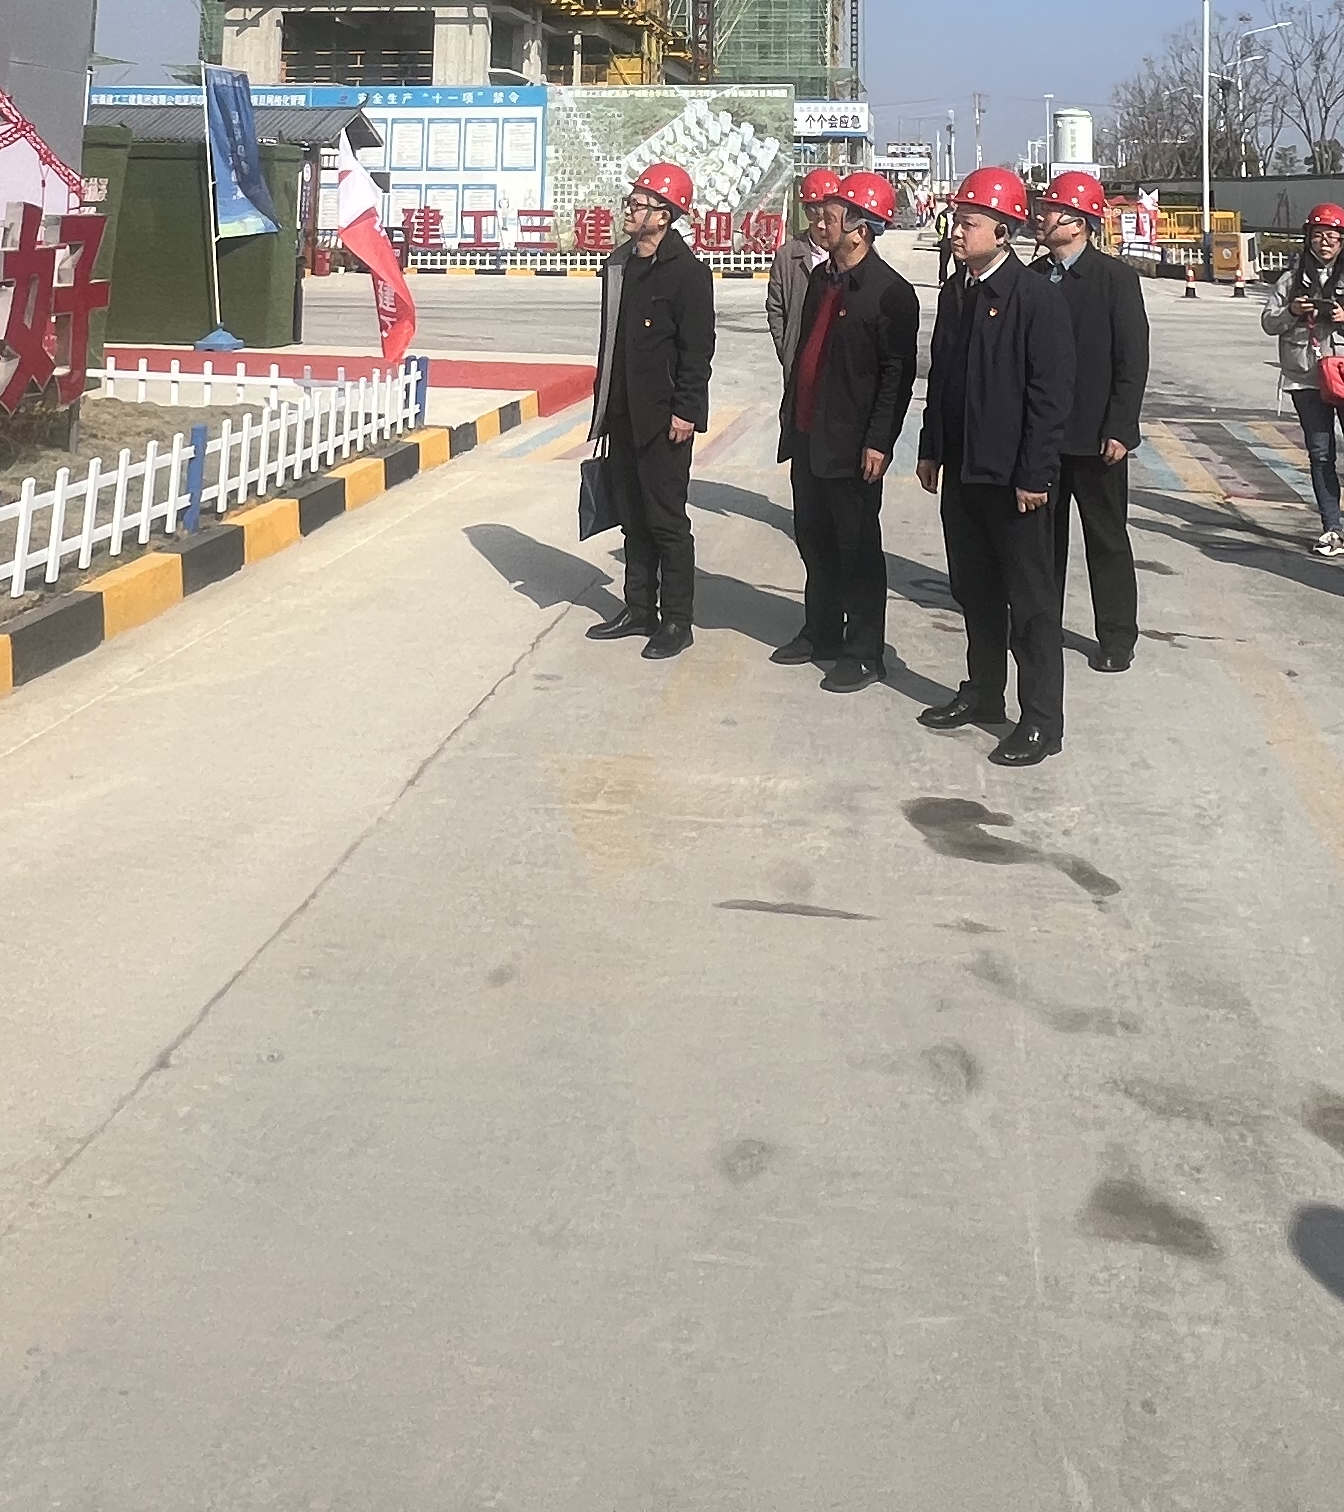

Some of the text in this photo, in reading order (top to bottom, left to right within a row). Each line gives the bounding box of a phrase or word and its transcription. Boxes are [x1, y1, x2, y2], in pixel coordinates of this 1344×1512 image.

[356, 92, 414, 104] 安全生产
[492, 91, 521, 104] 禁令
[805, 114, 862, 130] 个个会应急
